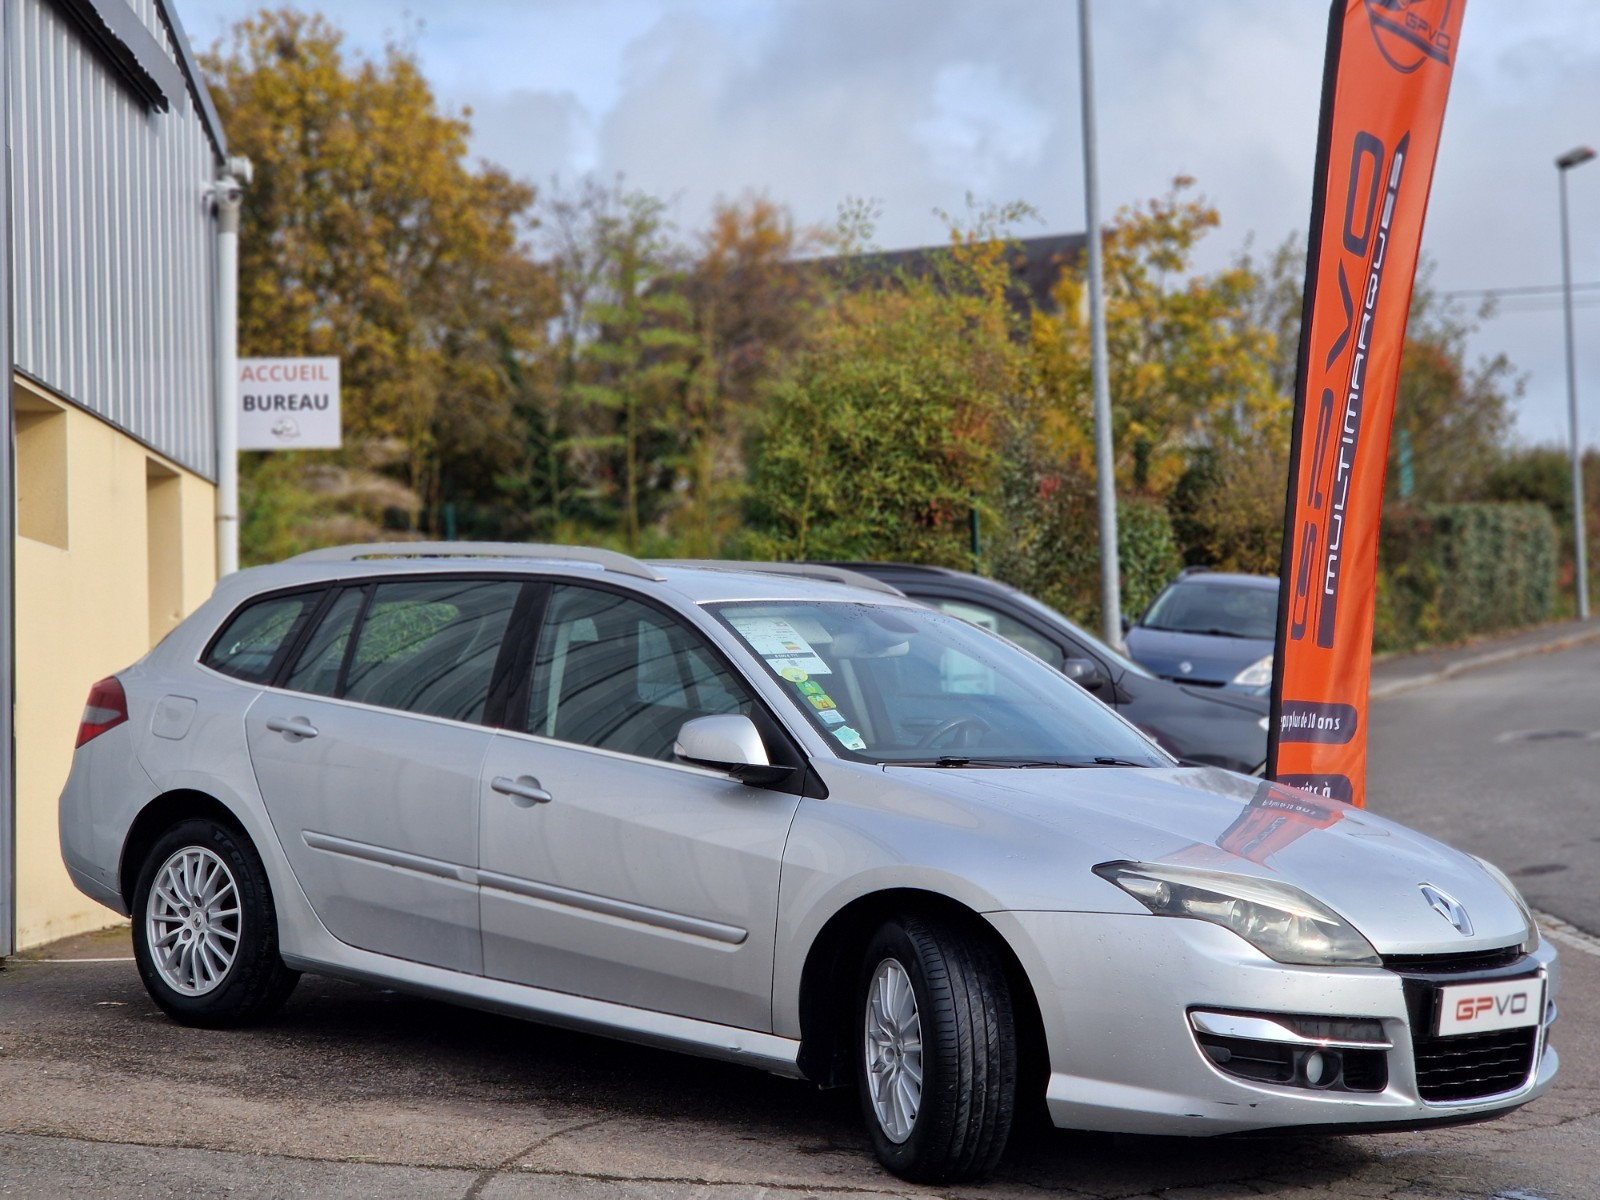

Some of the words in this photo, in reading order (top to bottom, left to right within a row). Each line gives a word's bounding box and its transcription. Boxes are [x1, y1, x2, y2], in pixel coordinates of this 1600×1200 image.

[1405, 11, 1451, 51] GPVO
[240, 364, 329, 382] ACCUEIL
[1290, 130, 1386, 641] GPVO
[1324, 152, 1403, 595] MULTIMARQUES
[242, 394, 329, 412] BUREAU
[1317, 717, 1340, 731] ans
[1455, 991, 1528, 1022] GPVO
